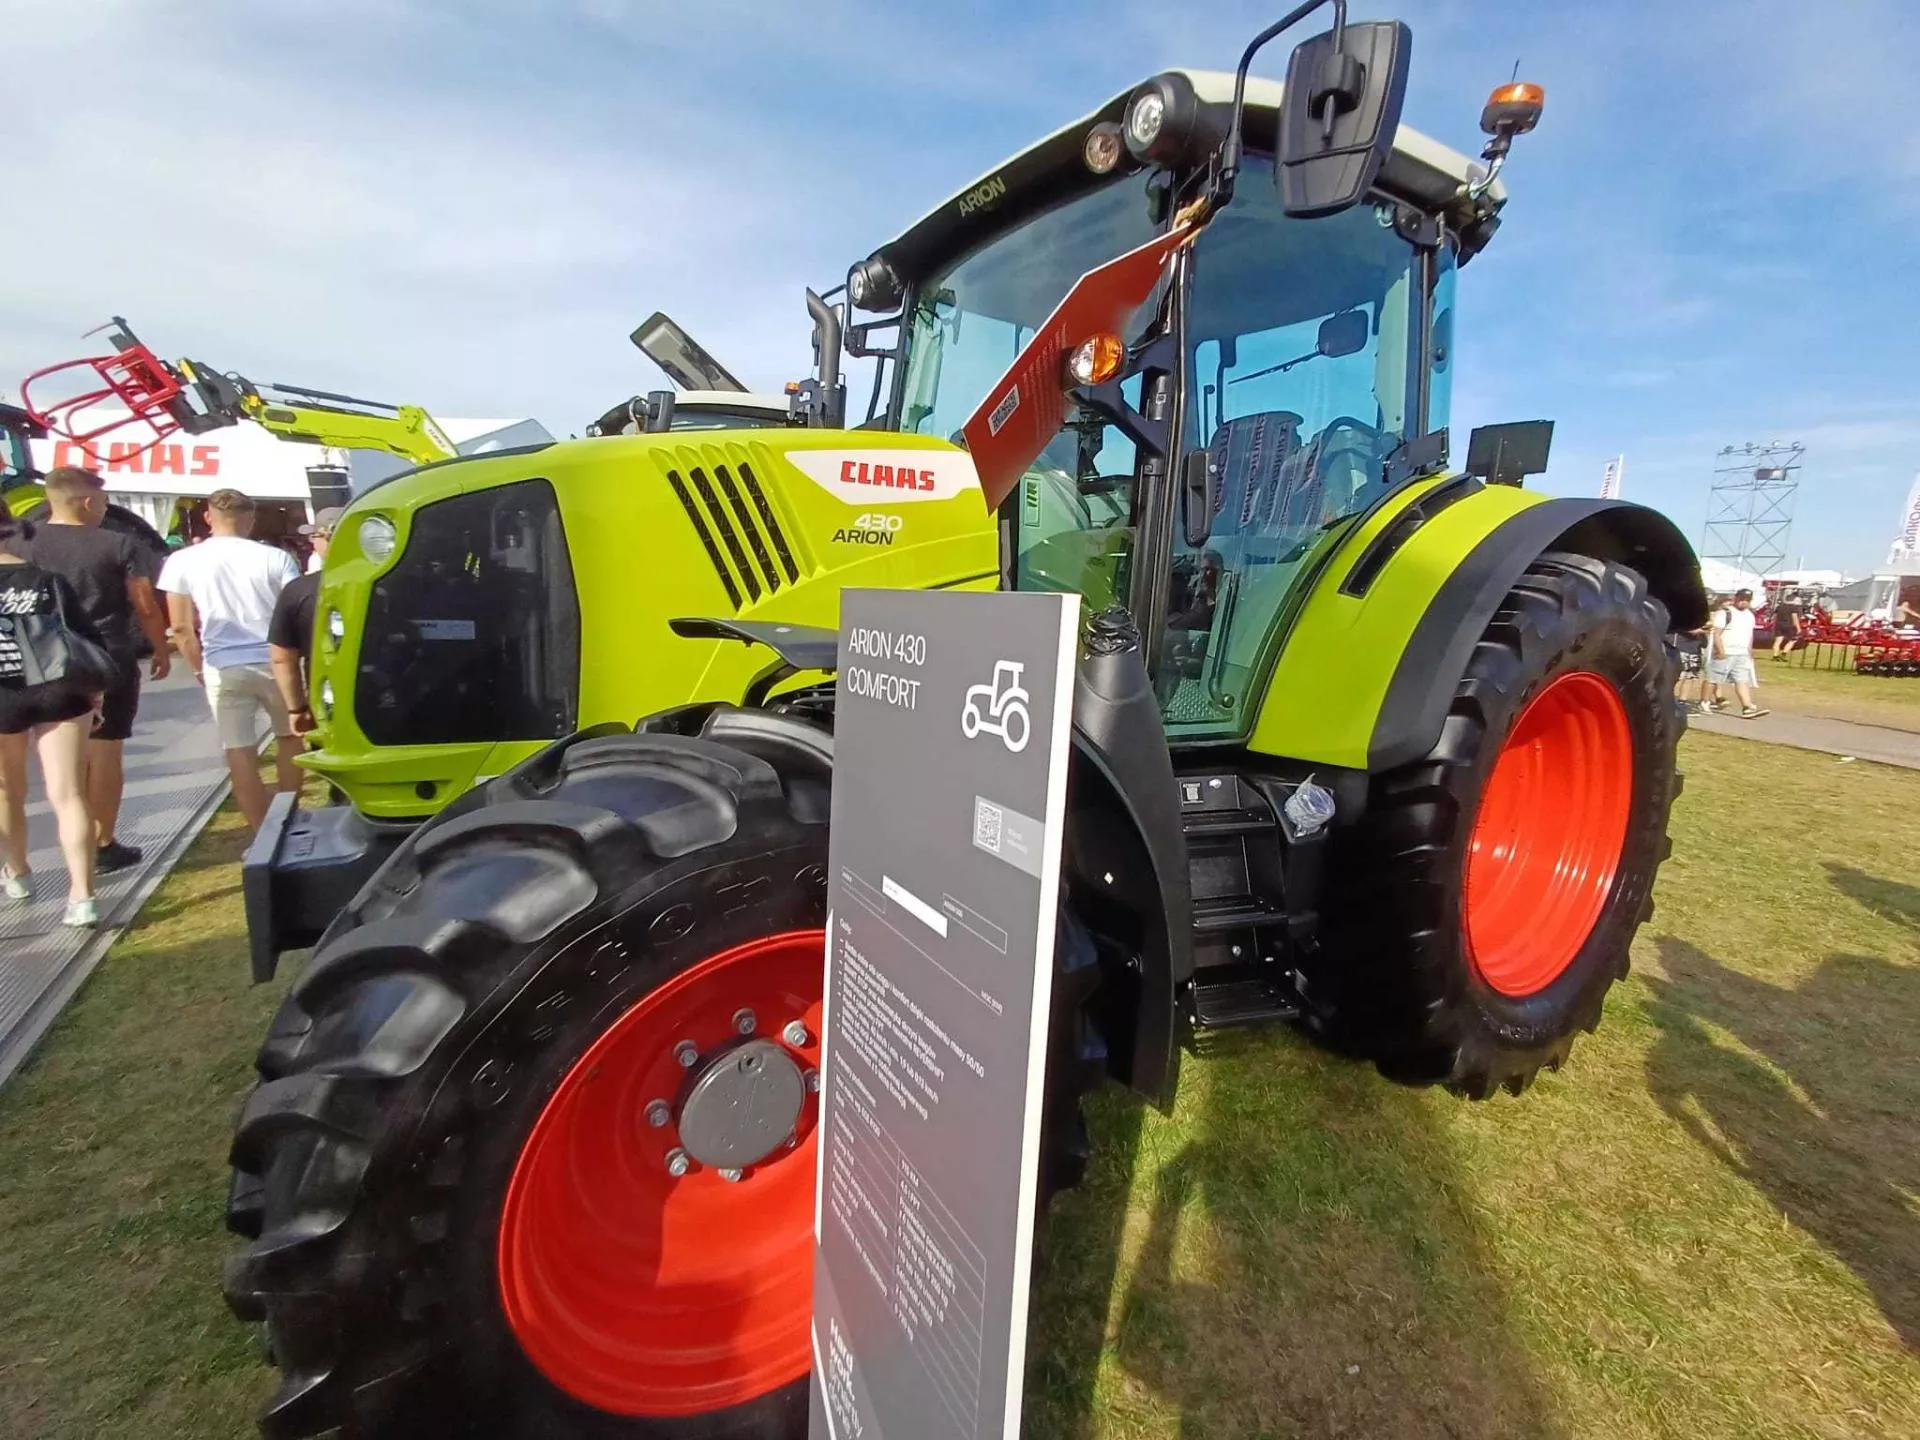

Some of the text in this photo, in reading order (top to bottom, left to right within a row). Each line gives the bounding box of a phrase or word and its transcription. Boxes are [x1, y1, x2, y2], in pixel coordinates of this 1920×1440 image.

[959, 176, 1006, 217] ARION
[53, 440, 220, 475] CLAAS
[840, 461, 935, 491] CLAAS
[832, 529, 893, 545] ARION
[854, 513, 903, 531] 430
[848, 627, 926, 666] ARION 430
[847, 667, 920, 710] COMFORT
